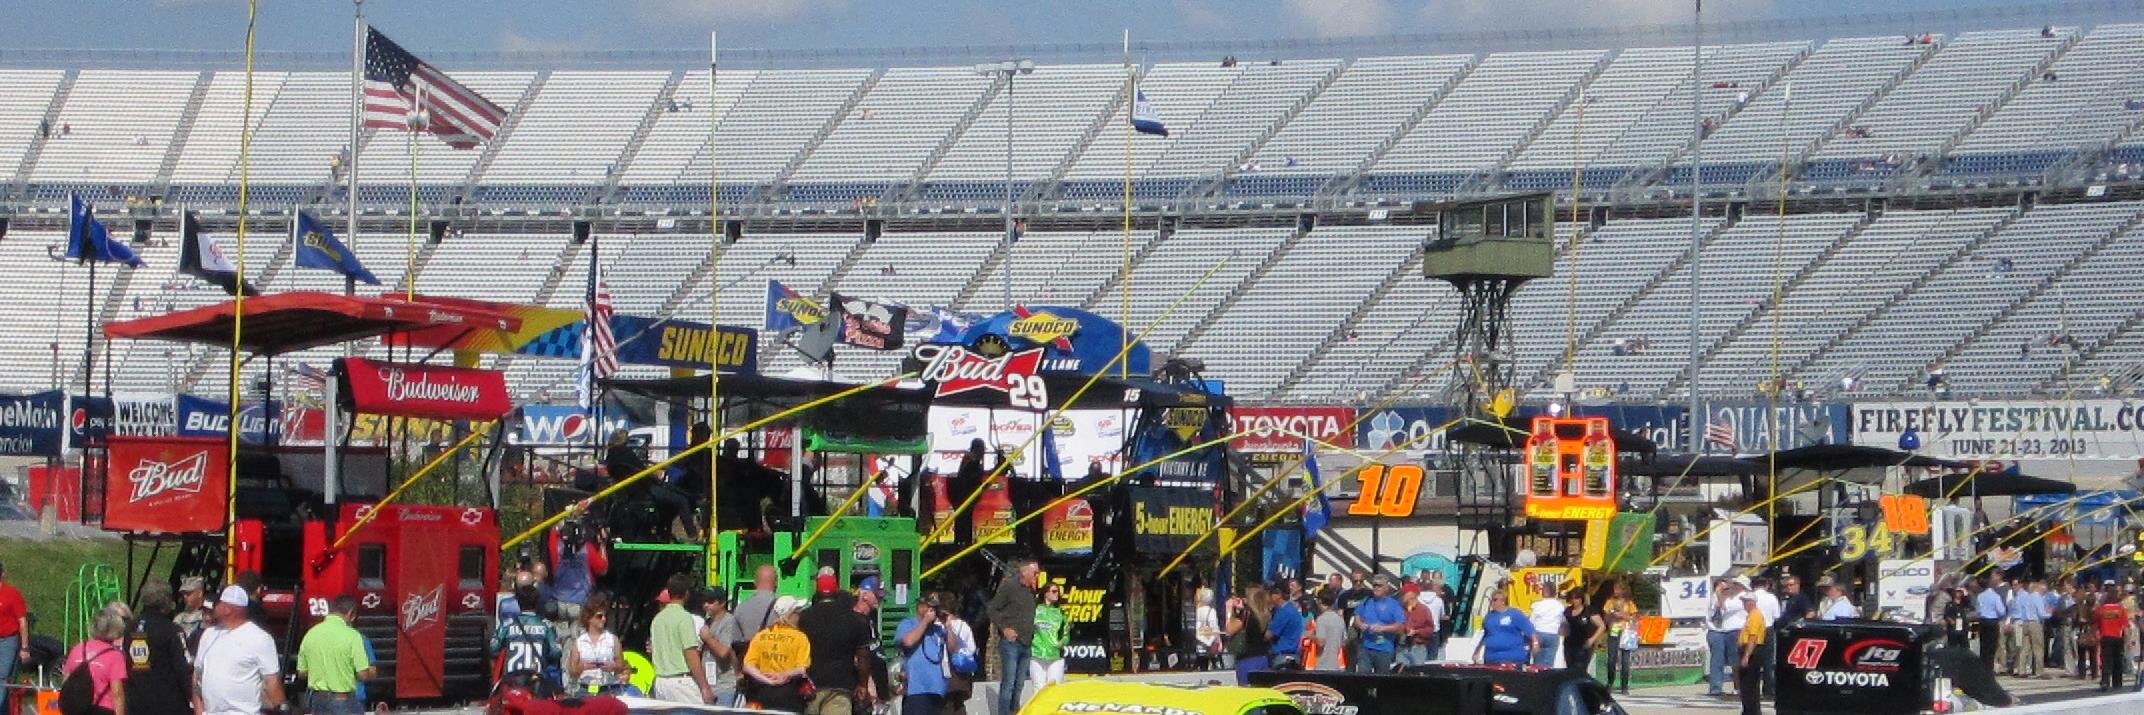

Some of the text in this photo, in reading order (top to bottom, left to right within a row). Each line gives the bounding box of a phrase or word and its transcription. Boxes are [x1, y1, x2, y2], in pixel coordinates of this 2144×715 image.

[1010, 320, 1075, 334] SUNOCO
[656, 326, 749, 367] SUNOCO
[915, 346, 1014, 383] Bud
[1052, 359, 1082, 371] LANE
[378, 366, 480, 404] Budweiser
[1007, 374, 1049, 411] 29
[1124, 388, 1141, 402] 15
[120, 401, 175, 423] WELCOME
[1239, 415, 1340, 438] TOYOTA
[1952, 439, 1995, 456] JUNE
[2050, 438, 2087, 455] 2013
[129, 456, 203, 497] Bud
[1348, 464, 1424, 517] 10
[1136, 502, 1213, 535] 5-hour ENERGY
[1562, 506, 1617, 518] ENERGY
[1879, 494, 1929, 535] 18
[1841, 521, 1893, 560] 34
[1680, 580, 1708, 599] 34
[309, 598, 329, 616] 29
[402, 588, 440, 627] Bud
[1787, 637, 1828, 669] 47
[1825, 671, 1889, 687] TOYOTA
